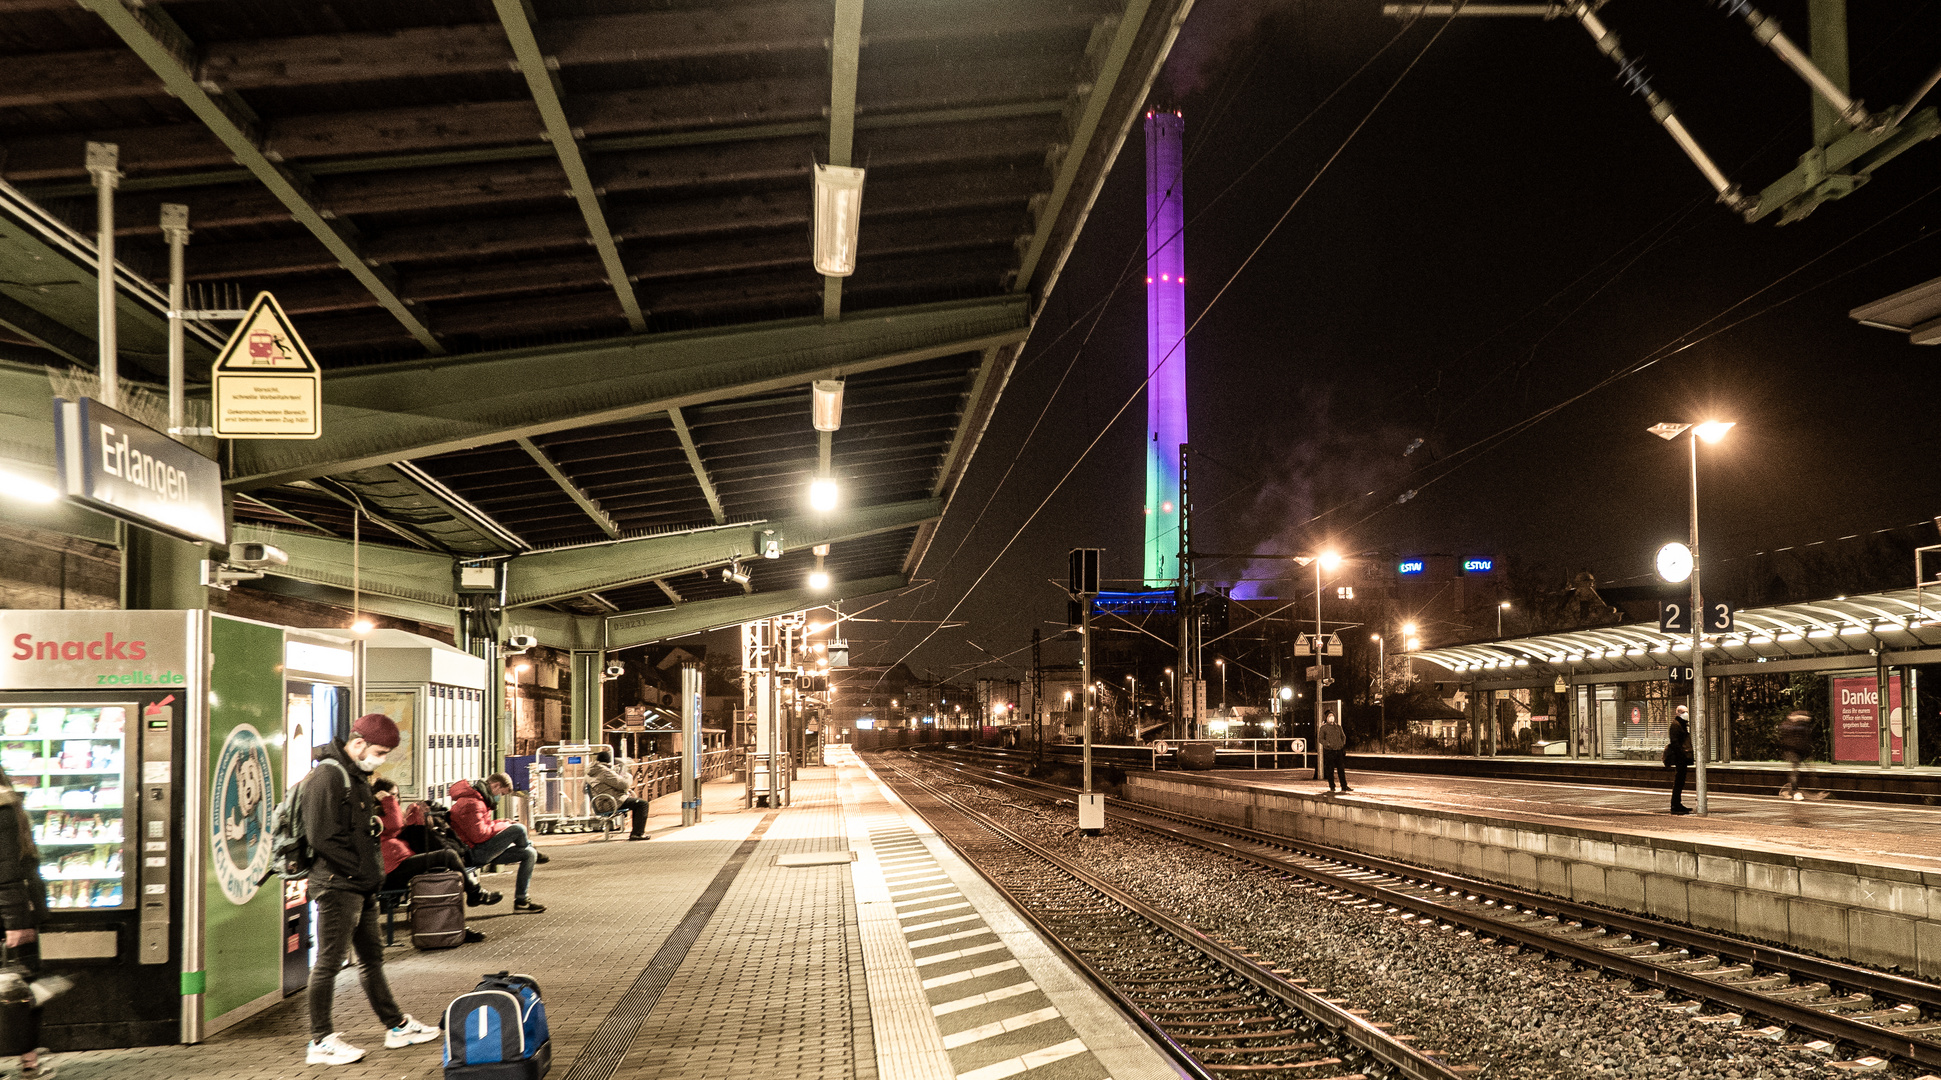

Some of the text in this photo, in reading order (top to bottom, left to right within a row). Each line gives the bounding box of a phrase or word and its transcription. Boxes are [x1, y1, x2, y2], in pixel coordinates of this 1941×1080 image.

[100, 423, 188, 503] Erlangen
[1400, 562, 1422, 573] ESTW
[1464, 561, 1491, 570] ESTW
[1665, 603, 1681, 629] 2
[1714, 603, 1730, 629] 3
[12, 631, 147, 661] Snacks
[97, 670, 184, 685] zoells.de
[801, 676, 811, 689] D
[1670, 667, 1694, 680] 4 D
[1841, 687, 1878, 705] Danke
[214, 839, 229, 880] ICH
[228, 873, 243, 898] BIN
